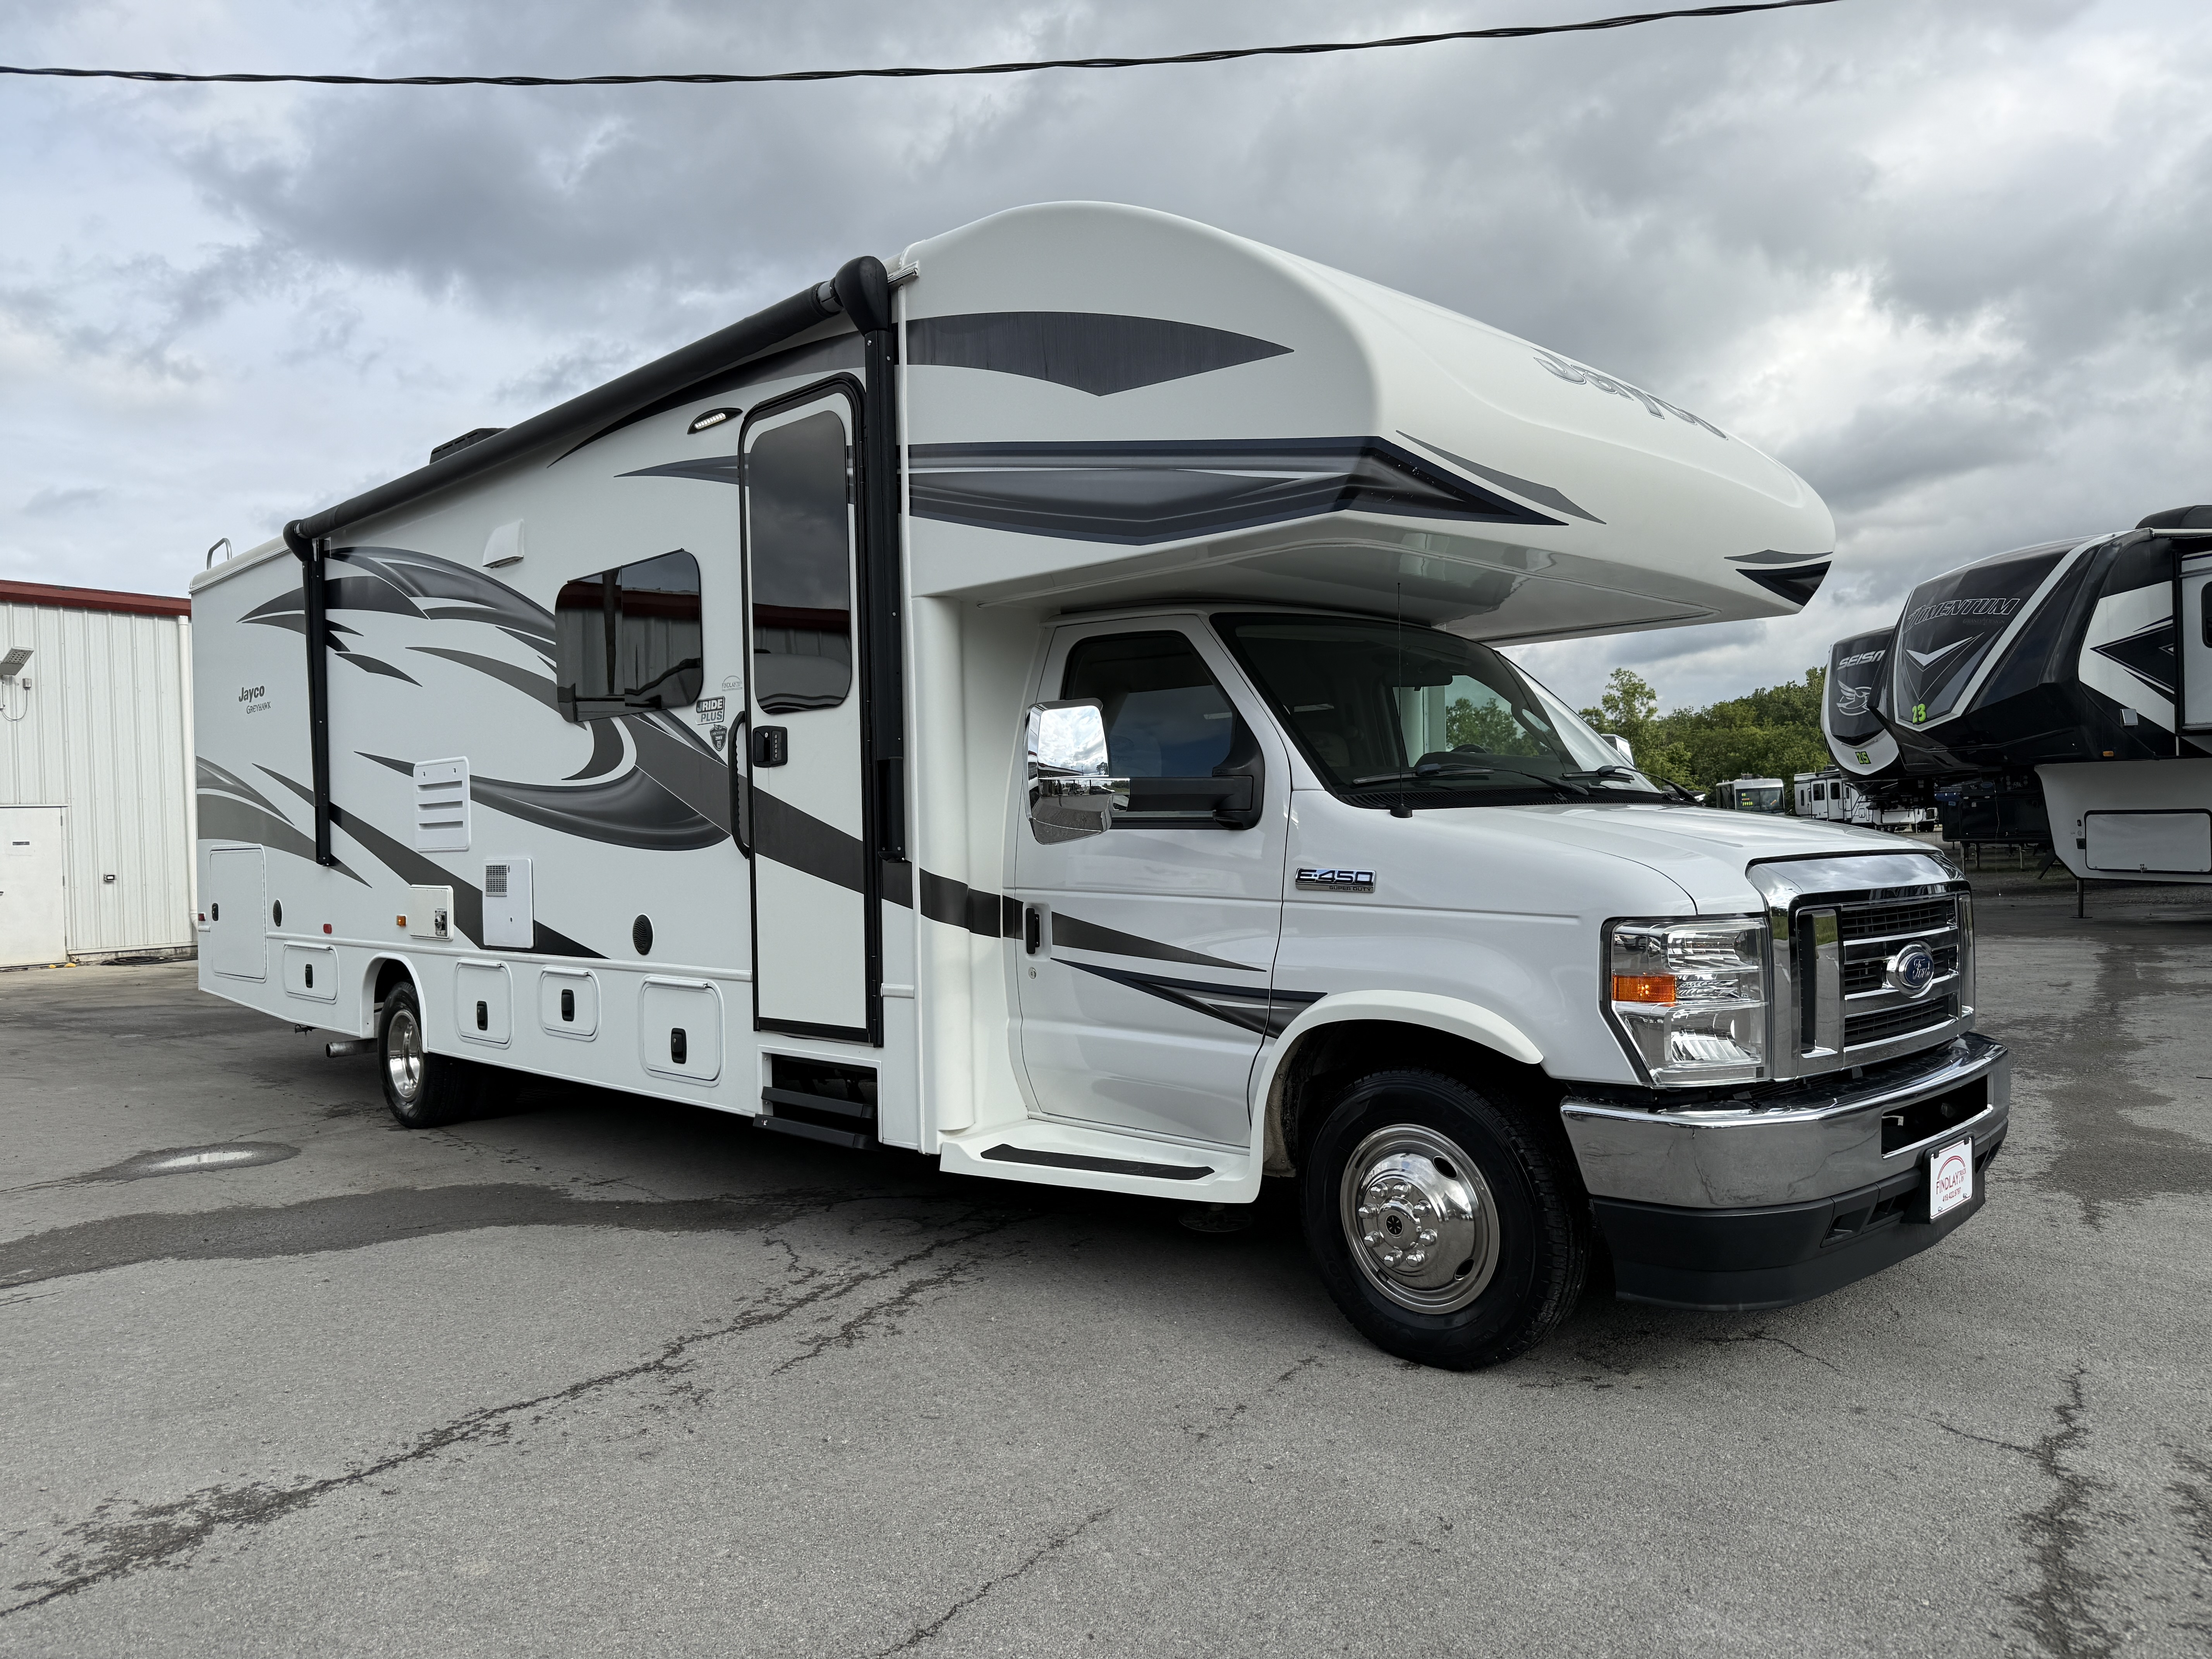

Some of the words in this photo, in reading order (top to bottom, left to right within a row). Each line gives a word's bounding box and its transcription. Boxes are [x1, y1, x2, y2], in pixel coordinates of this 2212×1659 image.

[1903, 598, 2020, 633] MOMENTUM
[239, 685, 264, 702] Jayco
[246, 701, 271, 714] GREYHAWK
[697, 699, 723, 712] JRIDE
[1912, 703, 1926, 723] 23
[701, 711, 723, 722] PLUS
[1856, 752, 1870, 764] 25
[1296, 869, 1373, 884] E-450
[1912, 958, 1930, 979] Ford
[1936, 1171, 1959, 1195] FINDLAY
